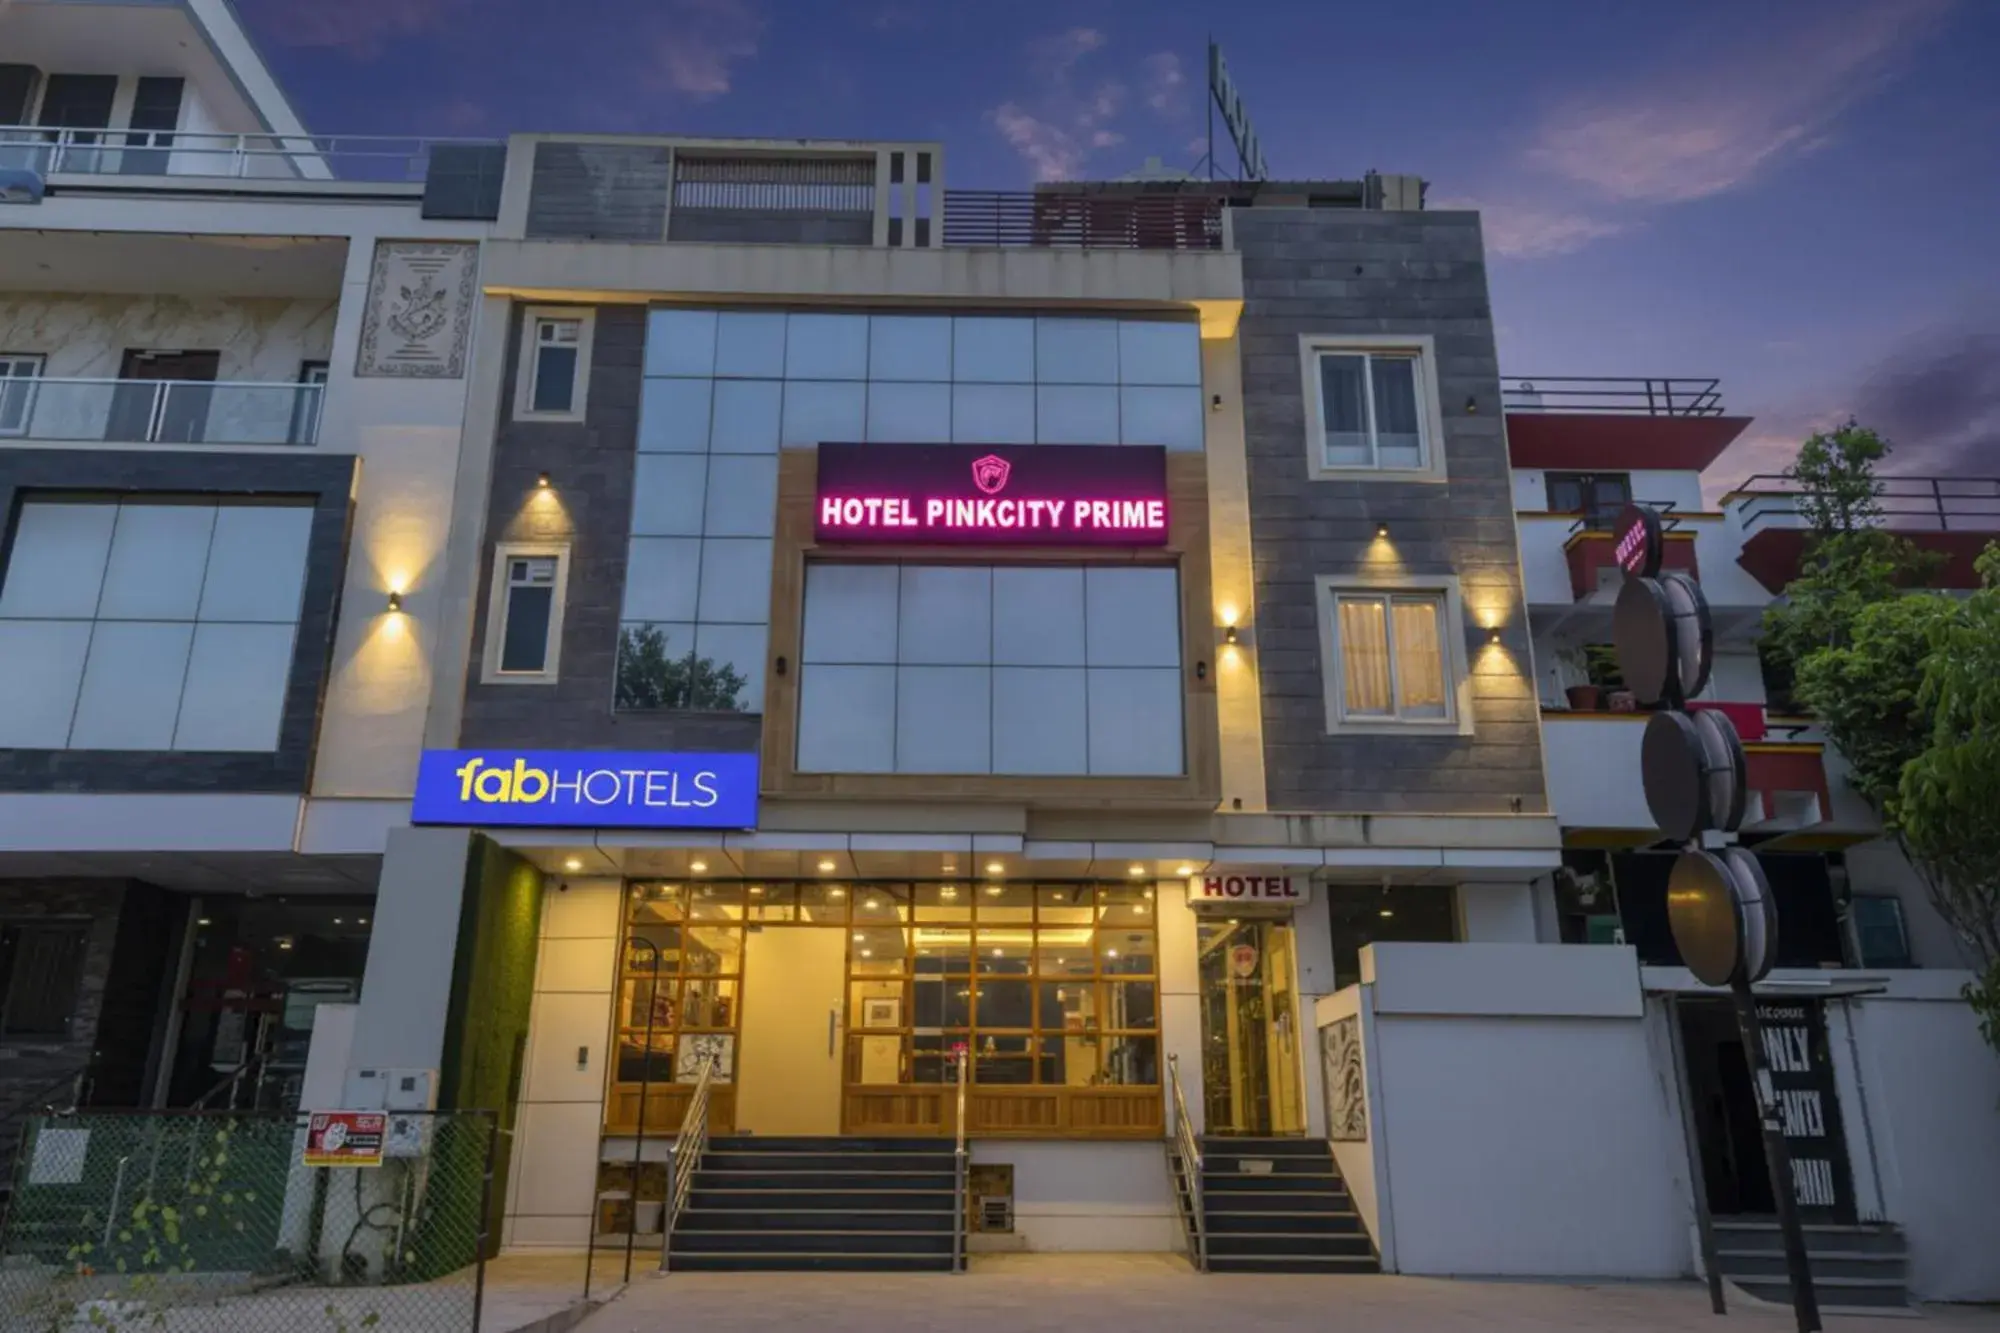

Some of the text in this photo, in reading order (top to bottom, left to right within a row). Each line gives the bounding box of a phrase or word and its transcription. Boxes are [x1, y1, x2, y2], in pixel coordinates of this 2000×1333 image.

[822, 497, 1165, 528] HOTEL PINKCITY PRIME
[456, 757, 718, 807] fabHOTELS
[1203, 876, 1299, 897] HOTEL
[1760, 1026, 1810, 1072] NLY
